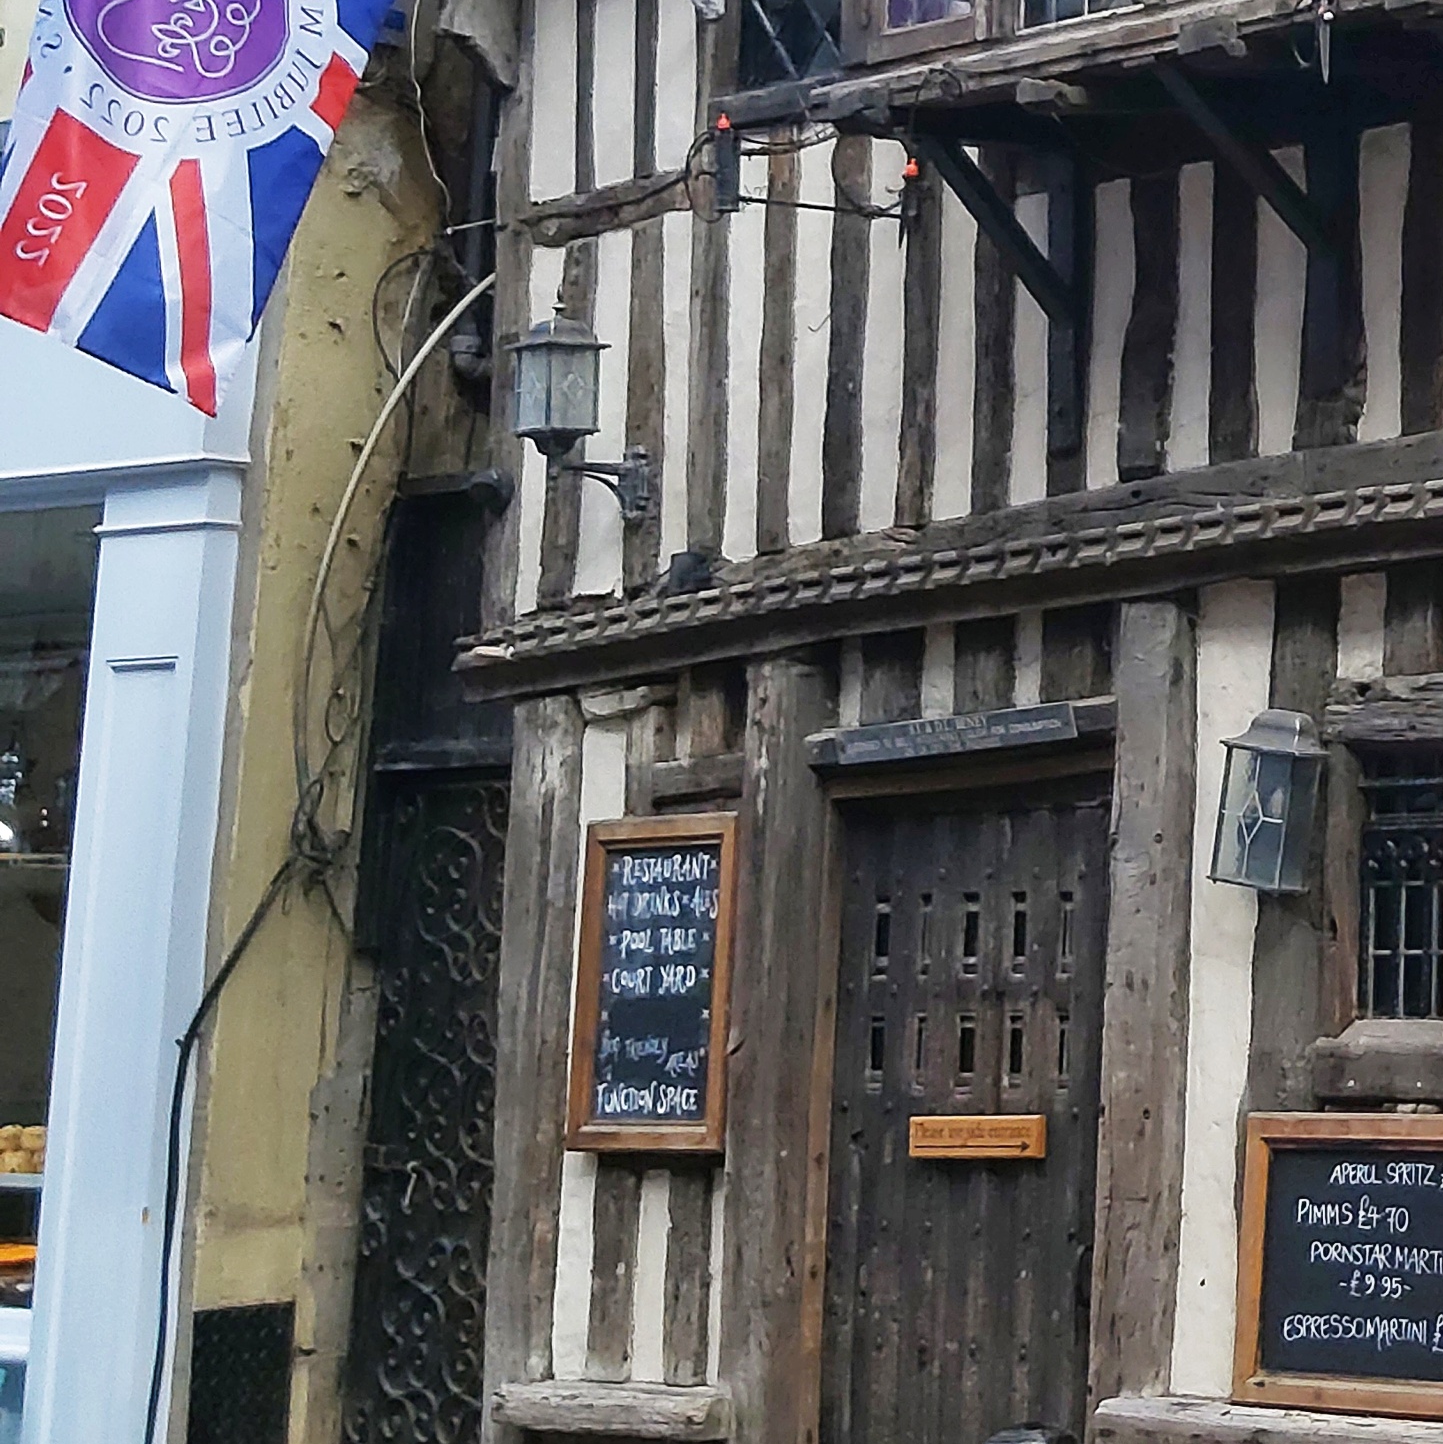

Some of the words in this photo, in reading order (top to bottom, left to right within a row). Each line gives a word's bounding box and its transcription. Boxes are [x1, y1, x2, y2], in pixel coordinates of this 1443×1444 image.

[622, 852, 711, 886] RESTAURANT
[620, 929, 654, 959] POOL
[660, 928, 697, 955] TABLE
[612, 966, 654, 994] COURT
[658, 964, 697, 994] YARD
[657, 1084, 699, 1115] SPACE
[1386, 1162, 1438, 1186] SPRITZ
[1296, 1198, 1353, 1226] PIMMS
[1311, 1241, 1391, 1270] PORNSTAR
